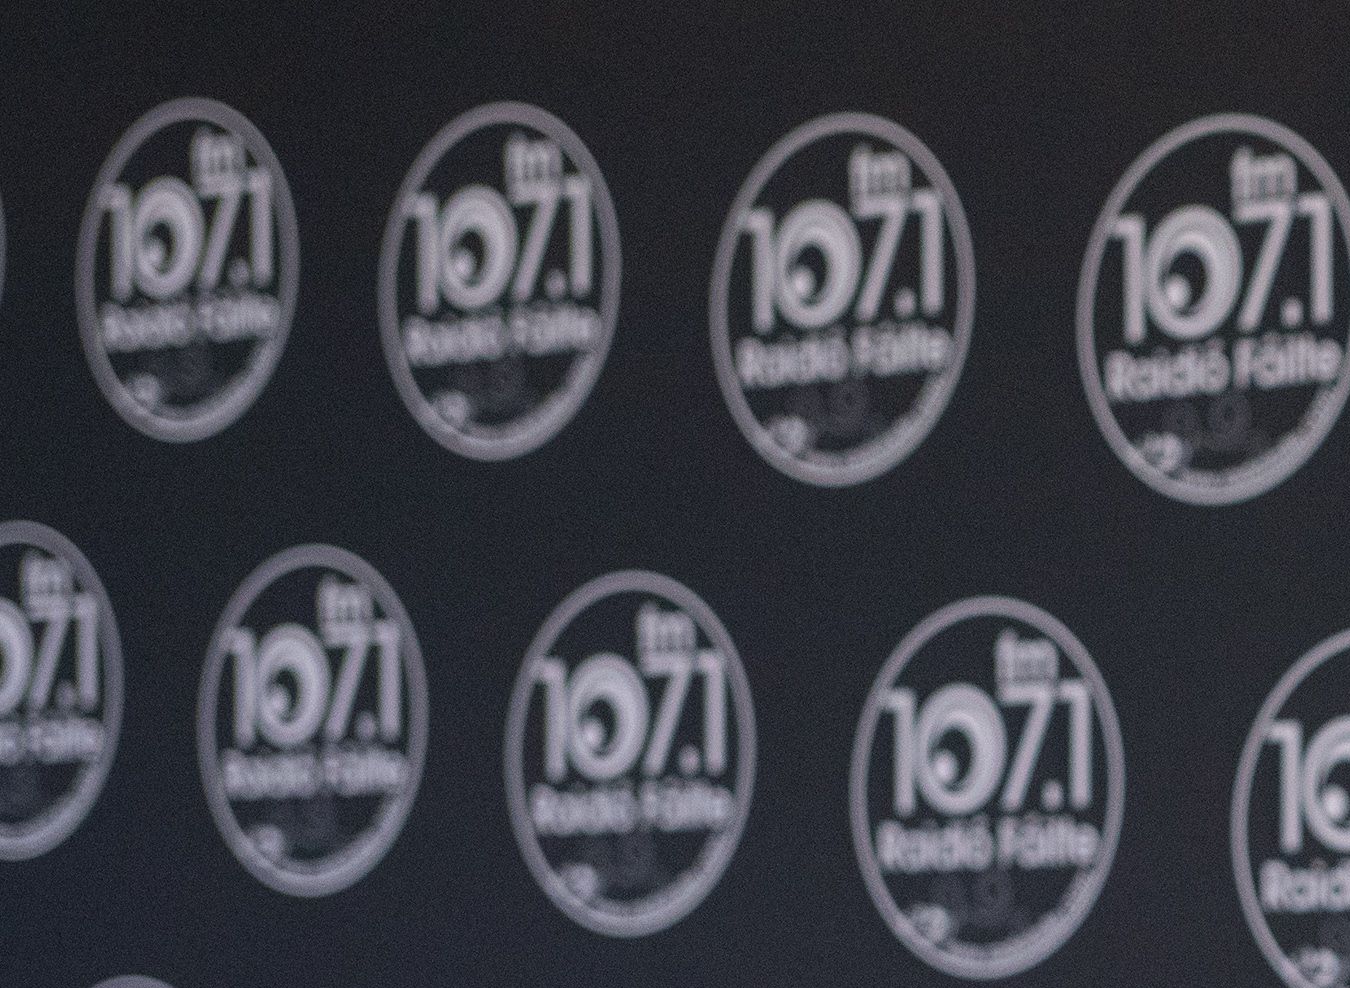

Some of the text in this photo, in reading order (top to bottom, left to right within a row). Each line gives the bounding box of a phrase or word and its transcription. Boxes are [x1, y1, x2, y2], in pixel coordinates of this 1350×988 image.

[106, 170, 270, 297] 107.1
[852, 147, 908, 195] fm
[1233, 150, 1294, 199] fm
[406, 179, 590, 312] 107.1
[741, 192, 941, 330] 107.1
[1111, 195, 1331, 341] 107.1
[221, 622, 397, 746] 107.1
[534, 653, 725, 779] 107.1
[882, 682, 1092, 814] 107.1
